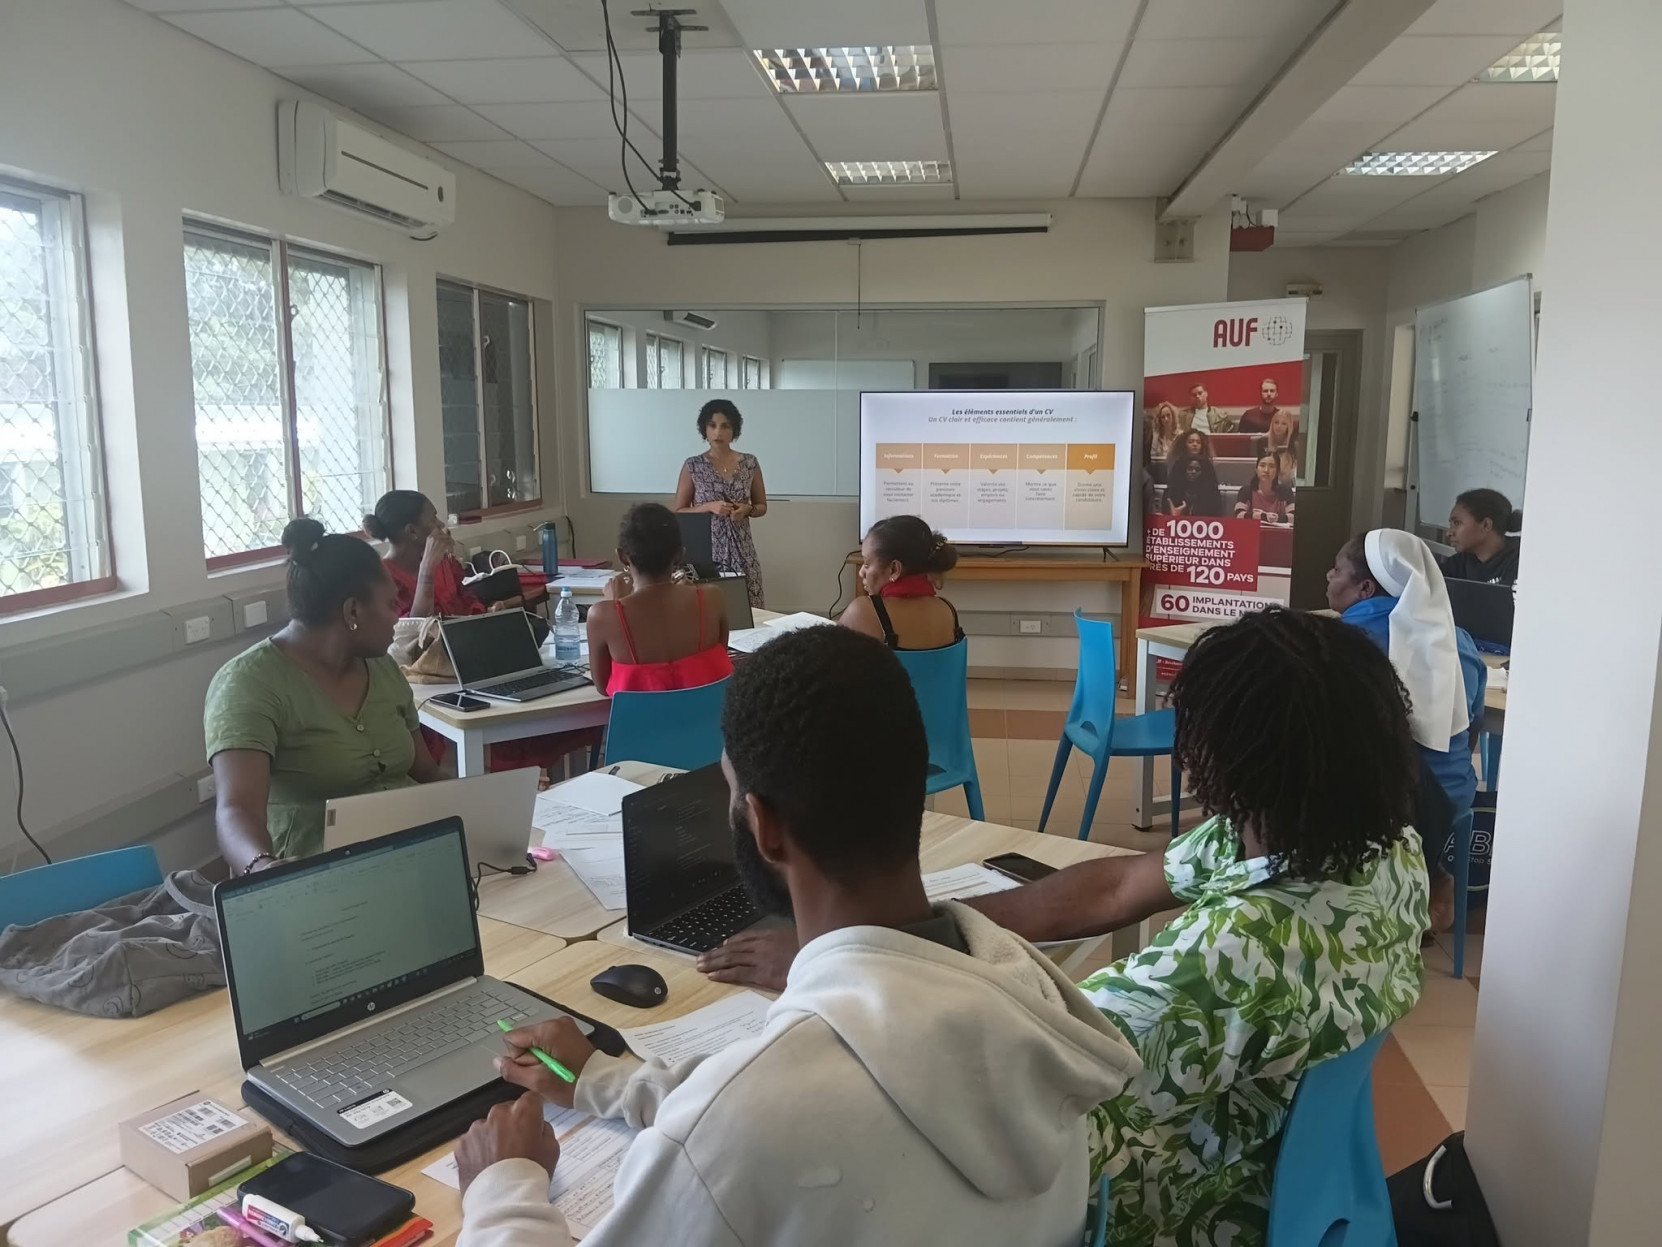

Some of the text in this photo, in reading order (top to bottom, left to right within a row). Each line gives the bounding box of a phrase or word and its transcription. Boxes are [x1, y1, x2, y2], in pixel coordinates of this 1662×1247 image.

[1213, 317, 1258, 348] AUF
[972, 416, 998, 424] efficace
[1152, 528, 1165, 536] DE
[1167, 520, 1224, 540] 1000
[1146, 545, 1235, 558] D'ENSEIGNEMENT
[1145, 553, 1231, 567] SUPÉRIEUR DANS
[1148, 561, 1254, 585] RÈS DE 120 PAYS
[1160, 594, 1190, 612] 60
[1192, 596, 1272, 610] IMPLANTATIO
[1192, 605, 1221, 615] DANS
[1224, 609, 1237, 617] LE
